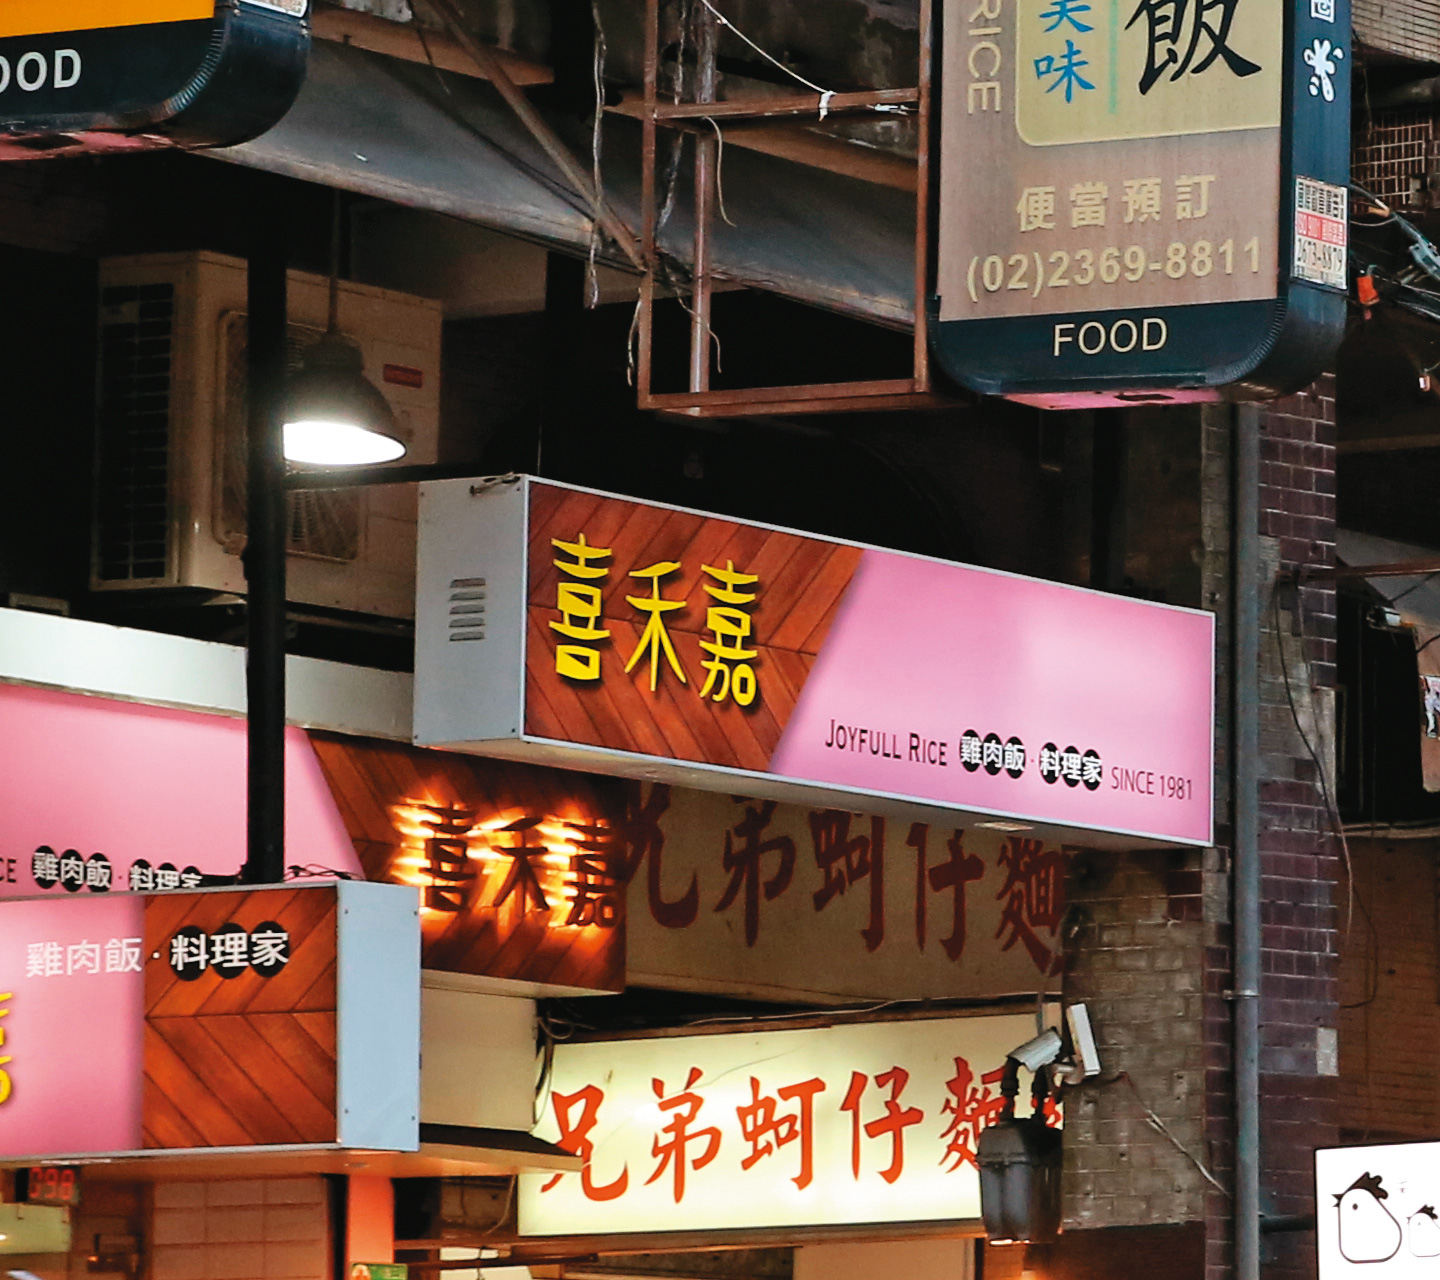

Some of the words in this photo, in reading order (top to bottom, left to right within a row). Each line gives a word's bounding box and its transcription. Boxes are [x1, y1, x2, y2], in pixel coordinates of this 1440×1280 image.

[1016, 174, 1215, 233] 便當預訂
[966, 236, 1260, 303] (02)2369-8811
[1053, 317, 1169, 357] FOOD
[550, 533, 760, 707] 喜禾嘉
[1110, 765, 1155, 796] SINCE
[1158, 773, 1194, 801] 1981
